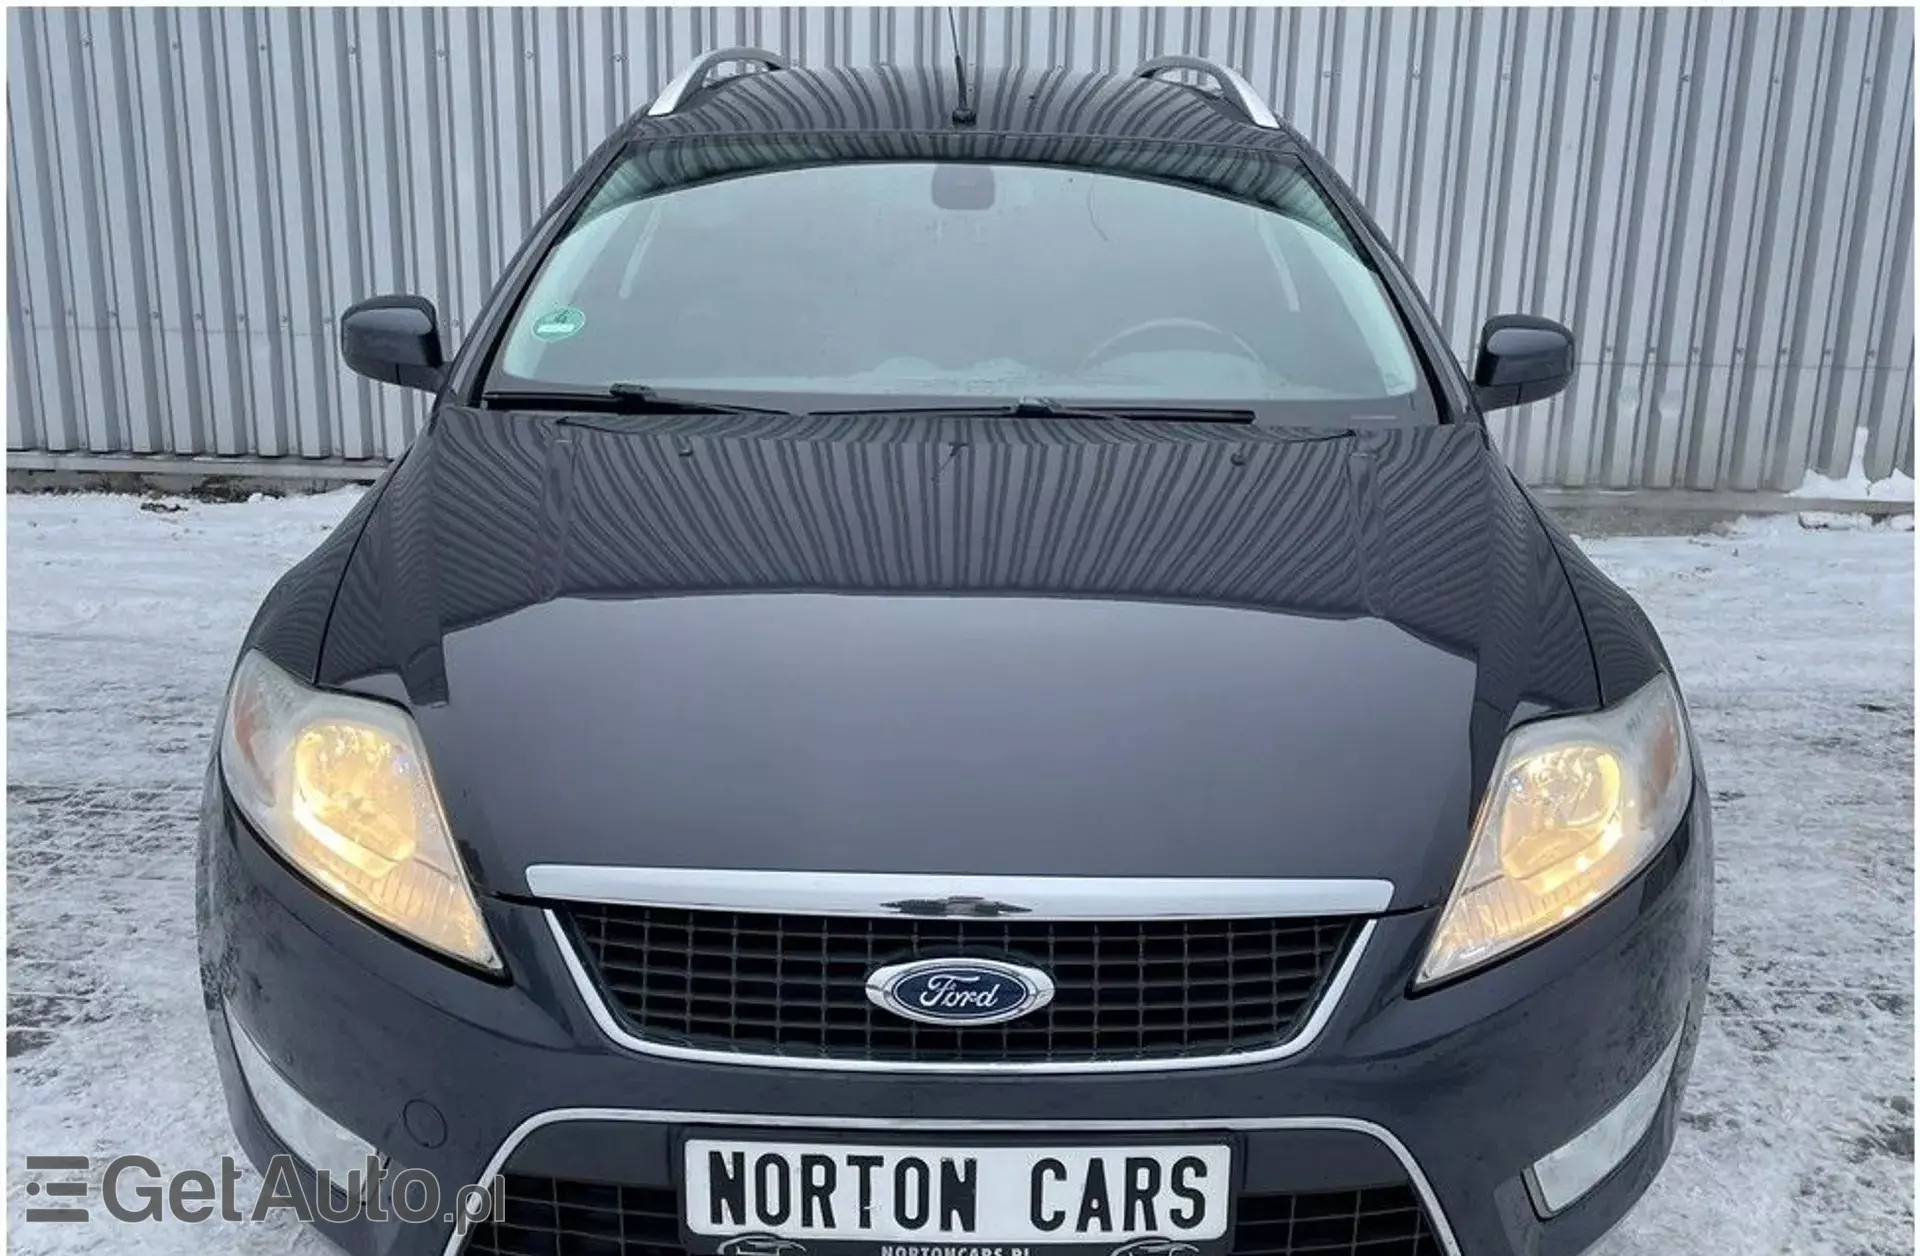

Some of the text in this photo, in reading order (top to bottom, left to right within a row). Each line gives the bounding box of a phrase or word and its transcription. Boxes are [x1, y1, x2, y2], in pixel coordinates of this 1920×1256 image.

[920, 974, 1000, 1007] Ford
[708, 1150, 1208, 1232] NORTON CARS
[881, 1246, 1029, 1256] NORTONCARSP
